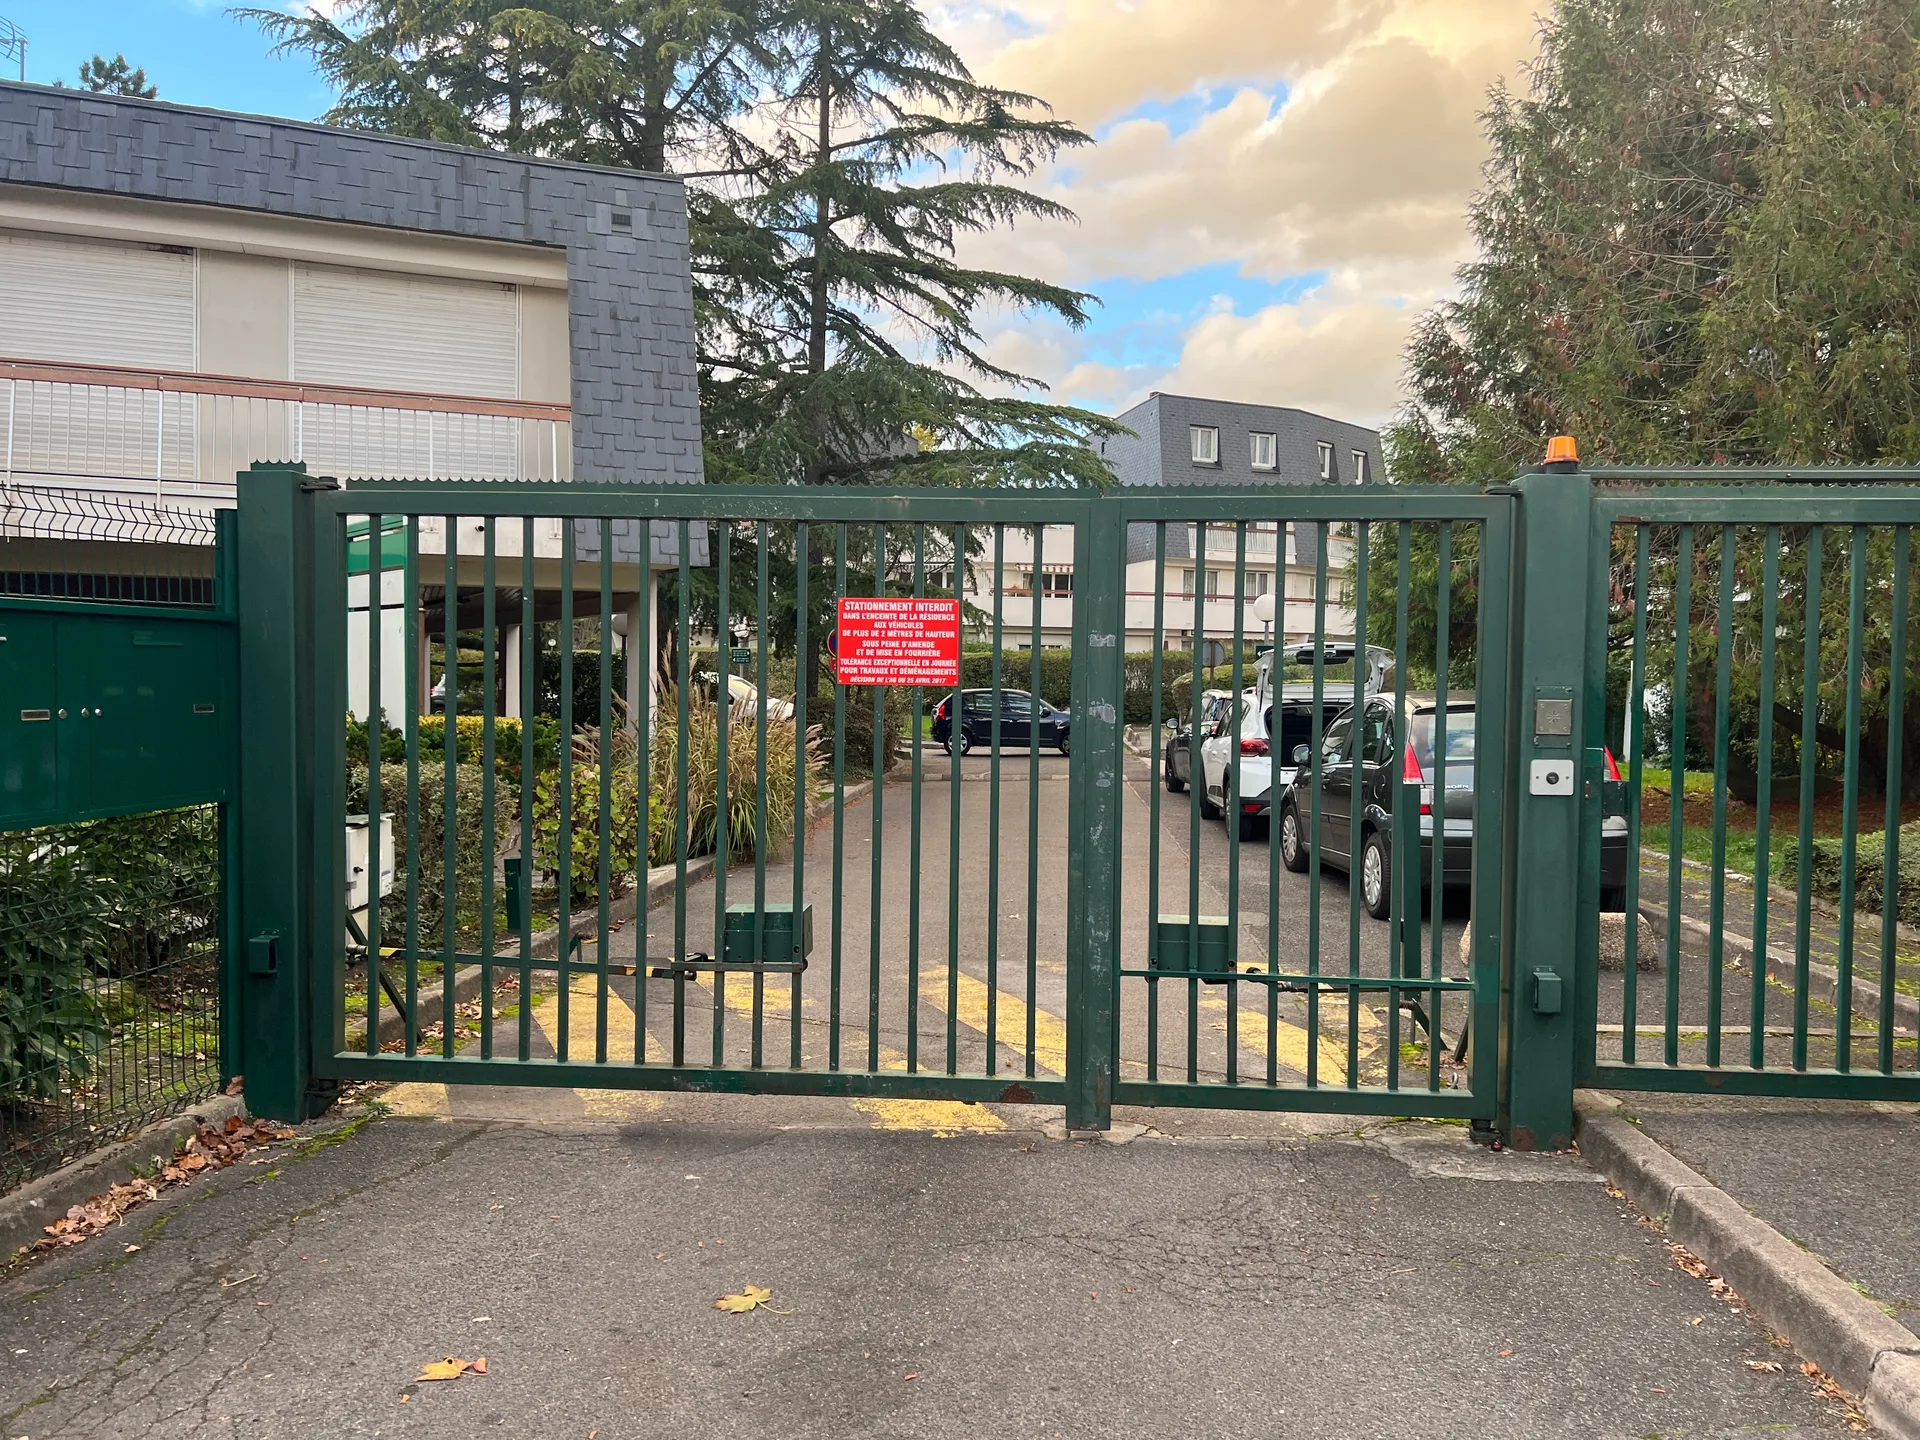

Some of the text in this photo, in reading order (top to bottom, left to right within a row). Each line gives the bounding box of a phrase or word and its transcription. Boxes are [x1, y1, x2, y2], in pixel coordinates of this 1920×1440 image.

[845, 602, 953, 612] STATIONNEMENT INTERDIT
[842, 612, 860, 620] DANS
[861, 612, 897, 620] L'ENCEINTE
[920, 612, 955, 620] RÉSIDENCE
[888, 620, 924, 629] VÉHICULES
[862, 640, 879, 648] SOUS
[881, 640, 900, 648] PEINE
[904, 648, 941, 657] FOURRIÈRE
[840, 657, 872, 666] TOLÉRANCE
[860, 667, 888, 675] TRAVAUX
[890, 667, 898, 675] ET
[900, 666, 956, 675] DÉMÉNAGEMENTS
[850, 675, 876, 683] DÉCISION
